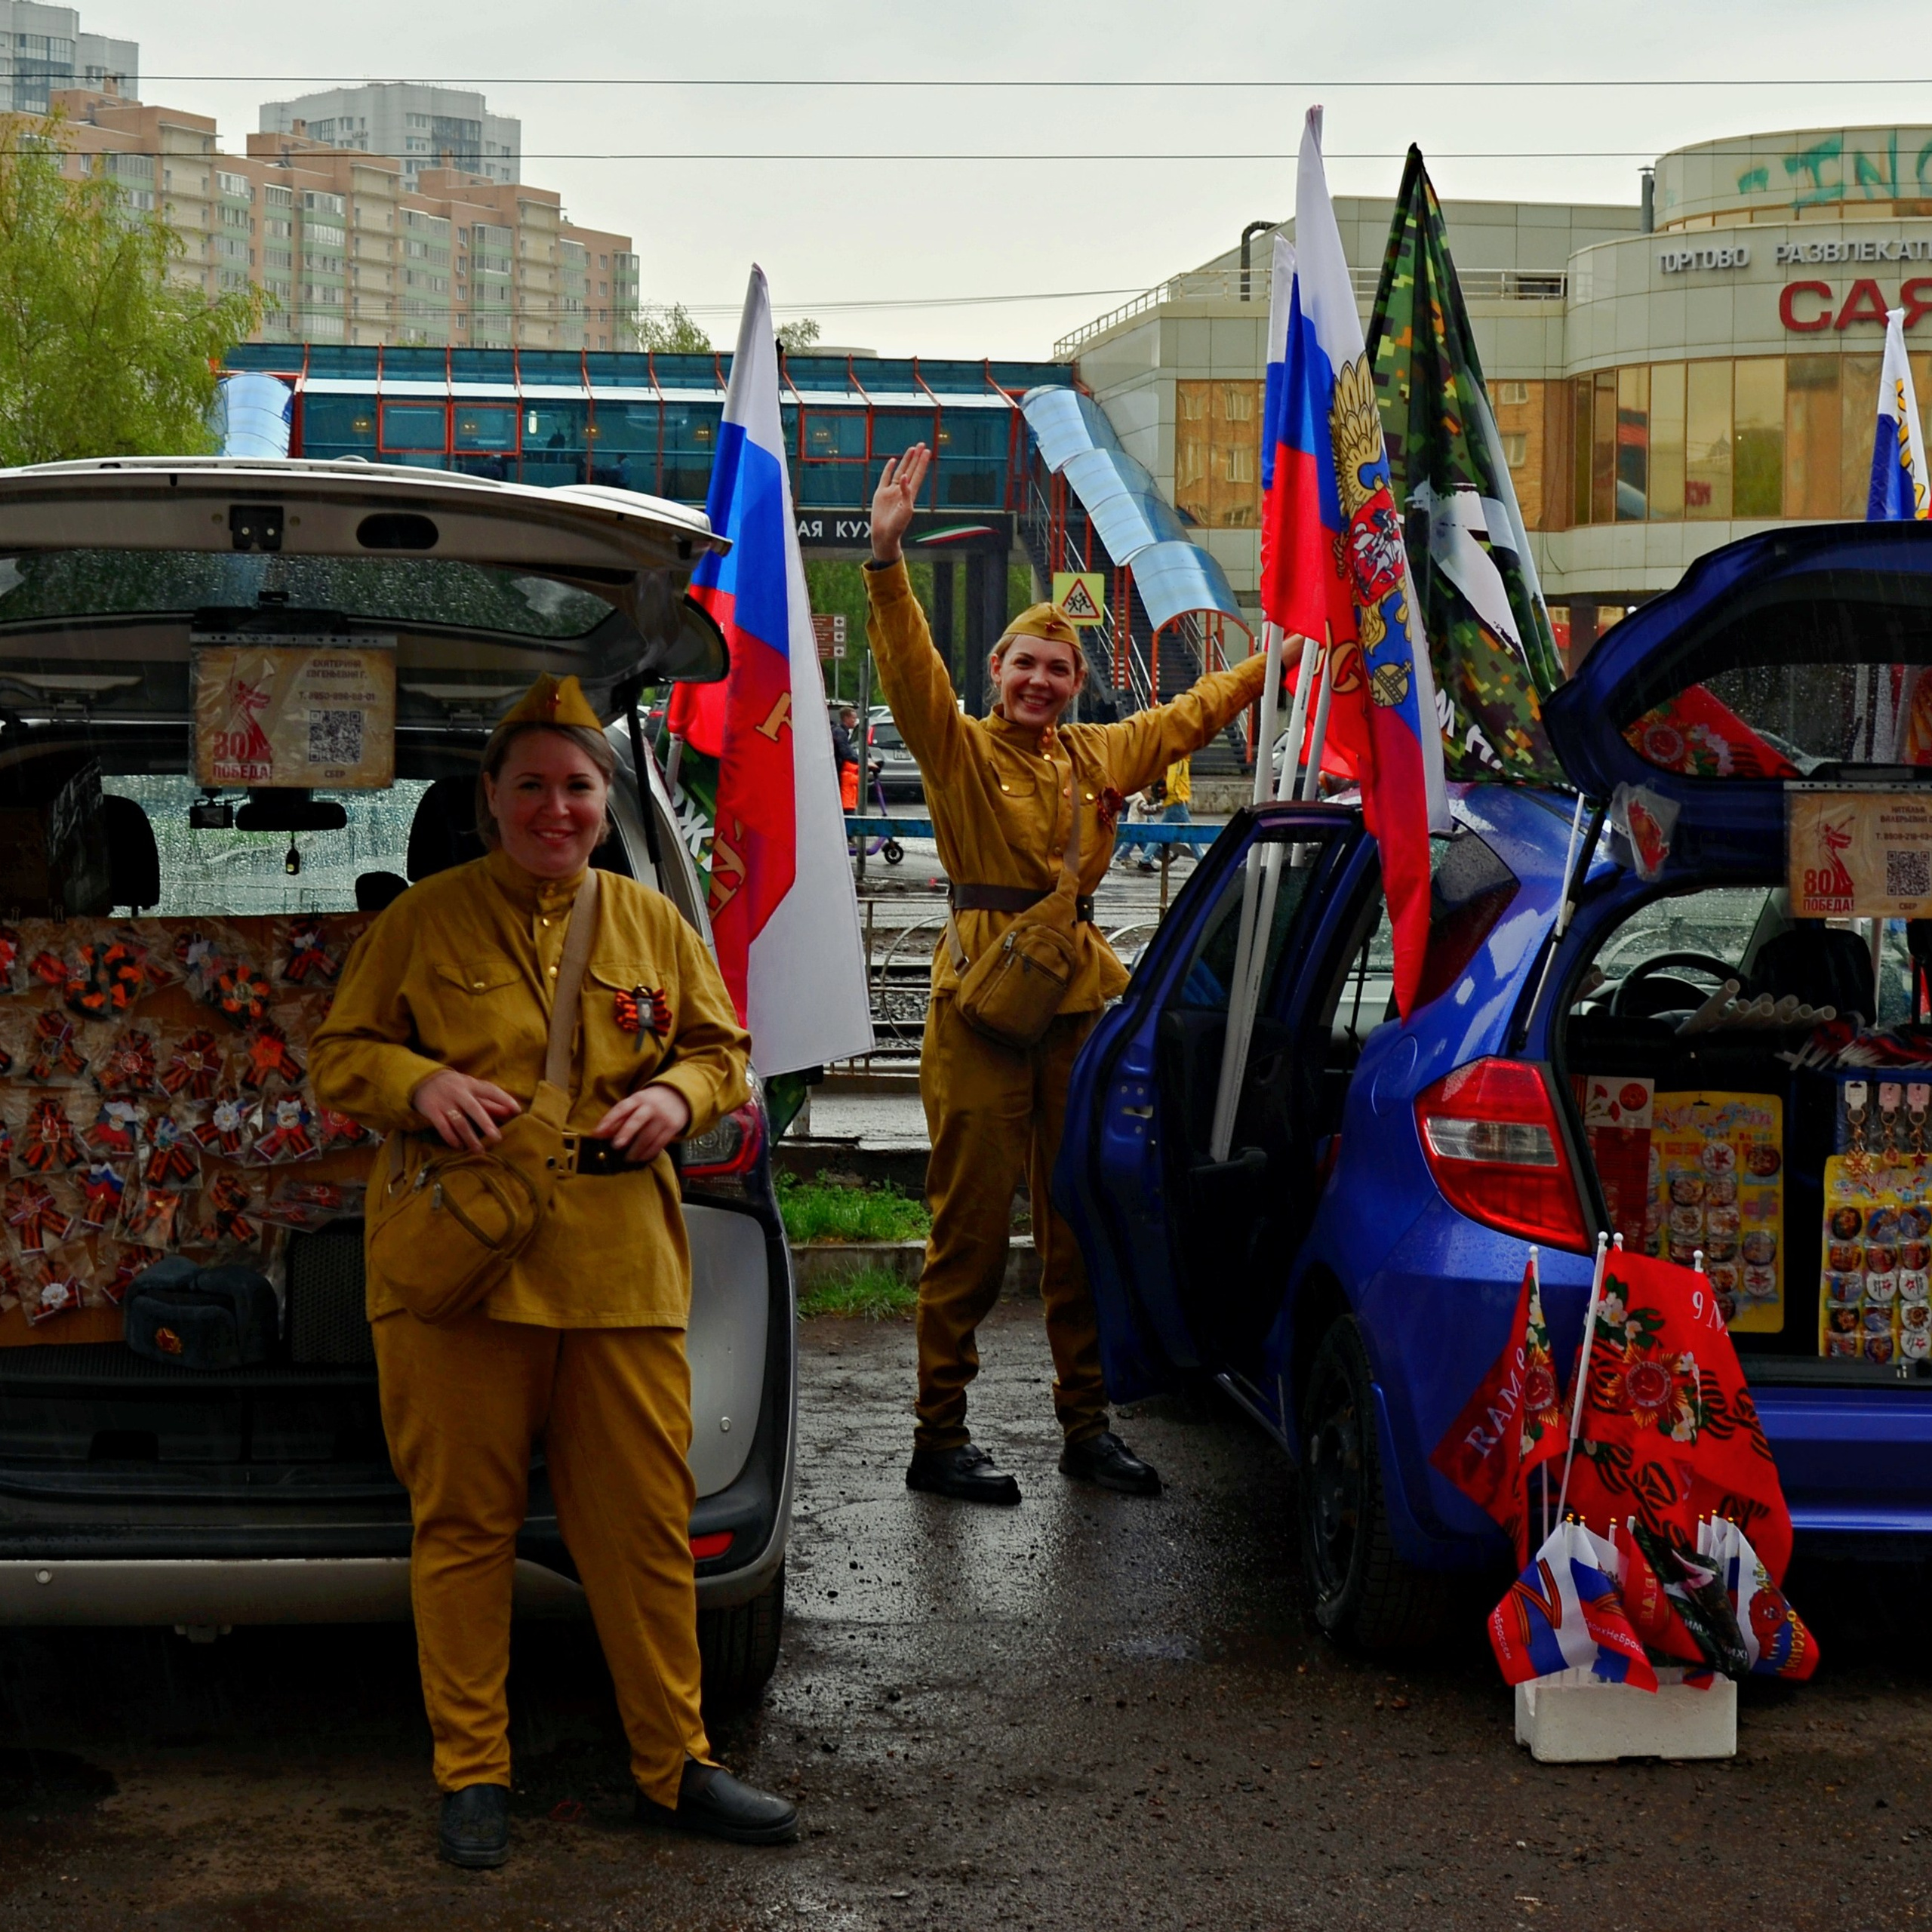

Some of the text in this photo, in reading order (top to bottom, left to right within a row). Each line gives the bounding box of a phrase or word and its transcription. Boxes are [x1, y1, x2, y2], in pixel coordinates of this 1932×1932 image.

[1657, 245, 1749, 273] ТОРГОВО
[213, 731, 249, 760] 80
[213, 762, 273, 780] ПОБЕДА!
[1804, 869, 1832, 894] 80
[1804, 899, 1854, 912] ПОБЕДА!
